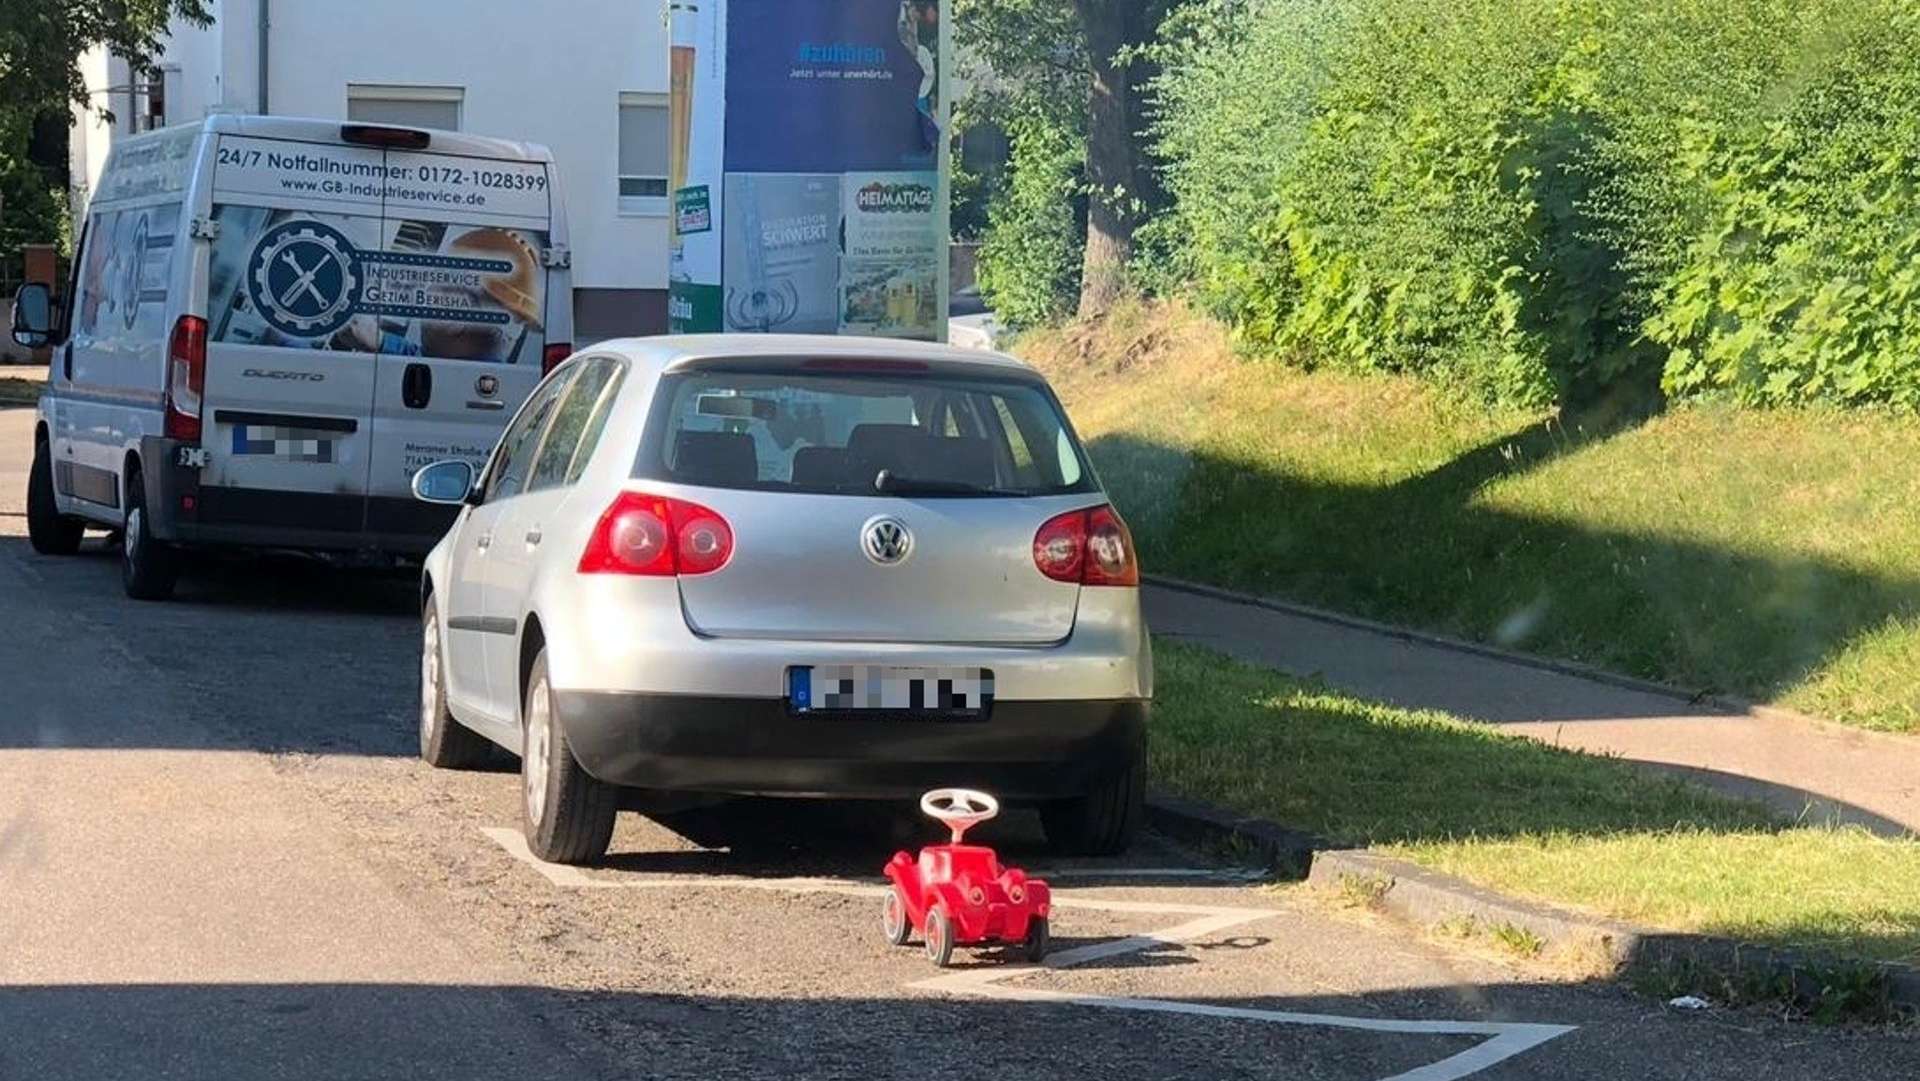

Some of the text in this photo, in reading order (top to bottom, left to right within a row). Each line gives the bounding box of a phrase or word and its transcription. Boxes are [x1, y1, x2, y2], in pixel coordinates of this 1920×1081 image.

[218, 148, 546, 192] 24/7 Notfallnummer: 0172-1028399
[281, 178, 486, 206] www.GB-Industrieservice.de
[762, 223, 828, 247] SCHWERT
[242, 368, 325, 382] DUCATO
